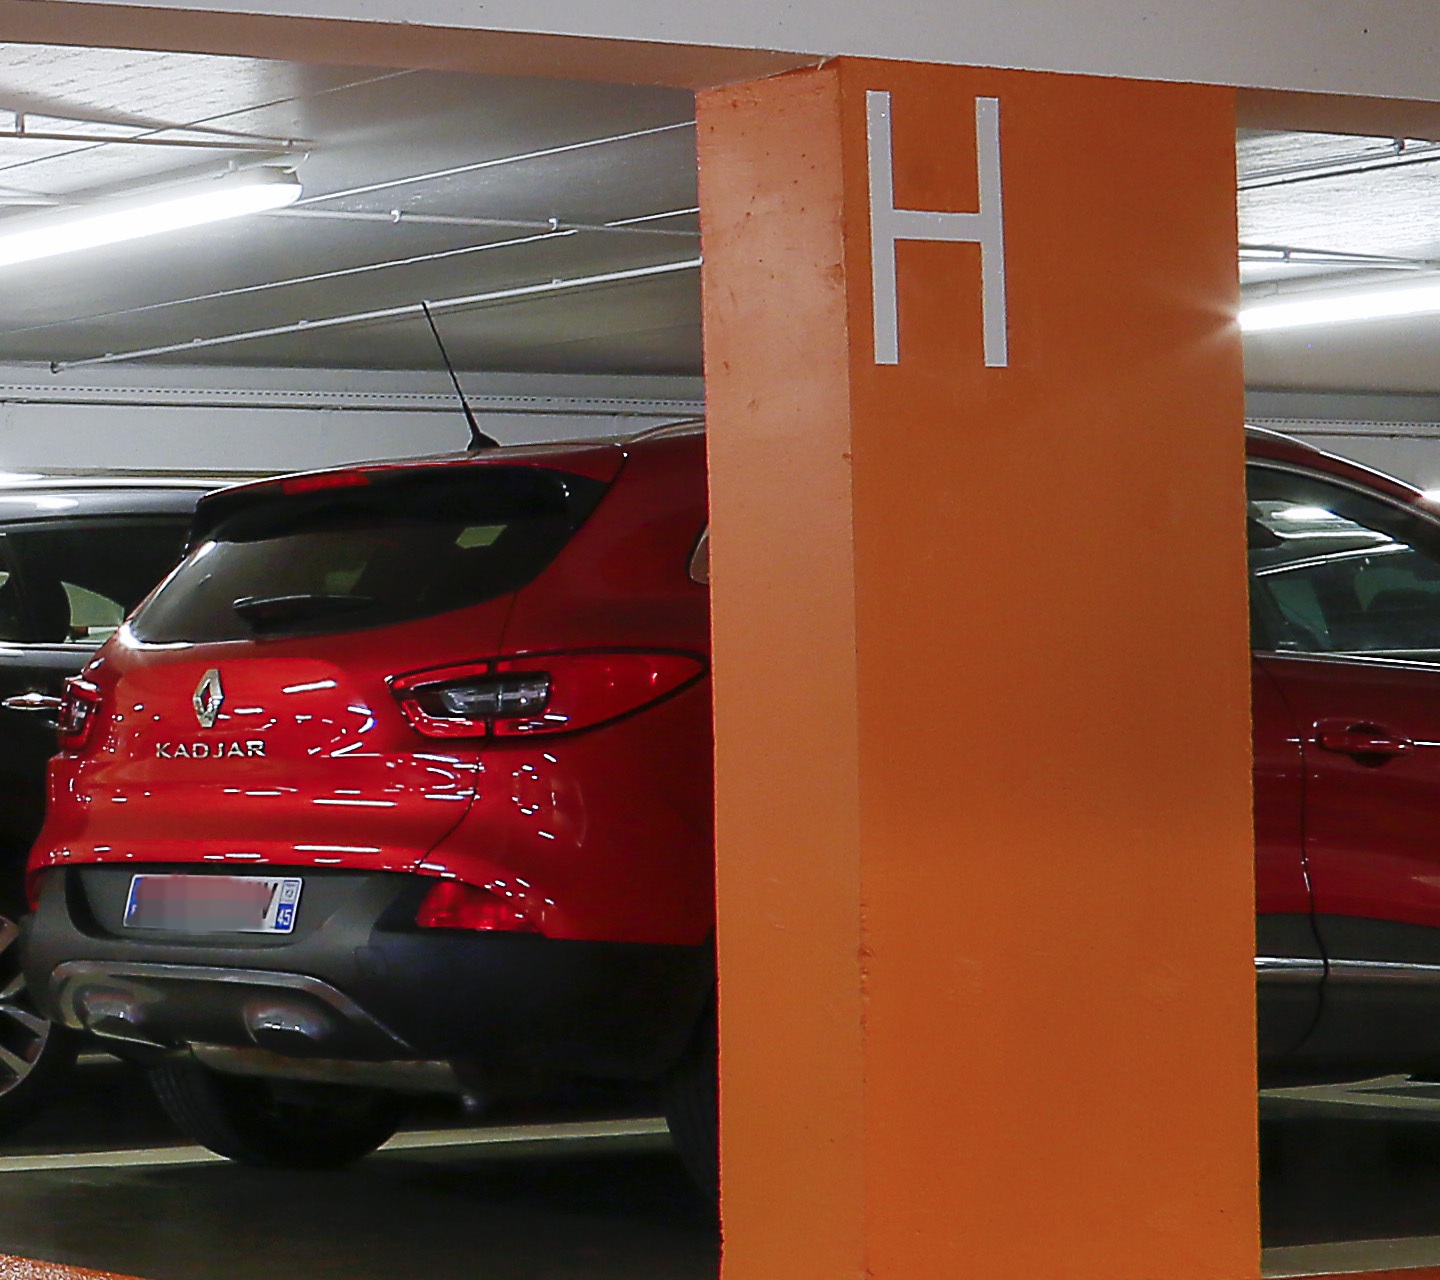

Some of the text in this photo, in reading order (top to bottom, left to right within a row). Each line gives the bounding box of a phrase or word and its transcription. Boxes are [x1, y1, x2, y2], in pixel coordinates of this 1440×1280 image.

[866, 90, 1007, 367] H
[155, 740, 266, 758] KADJAR
[277, 909, 292, 926] 45
